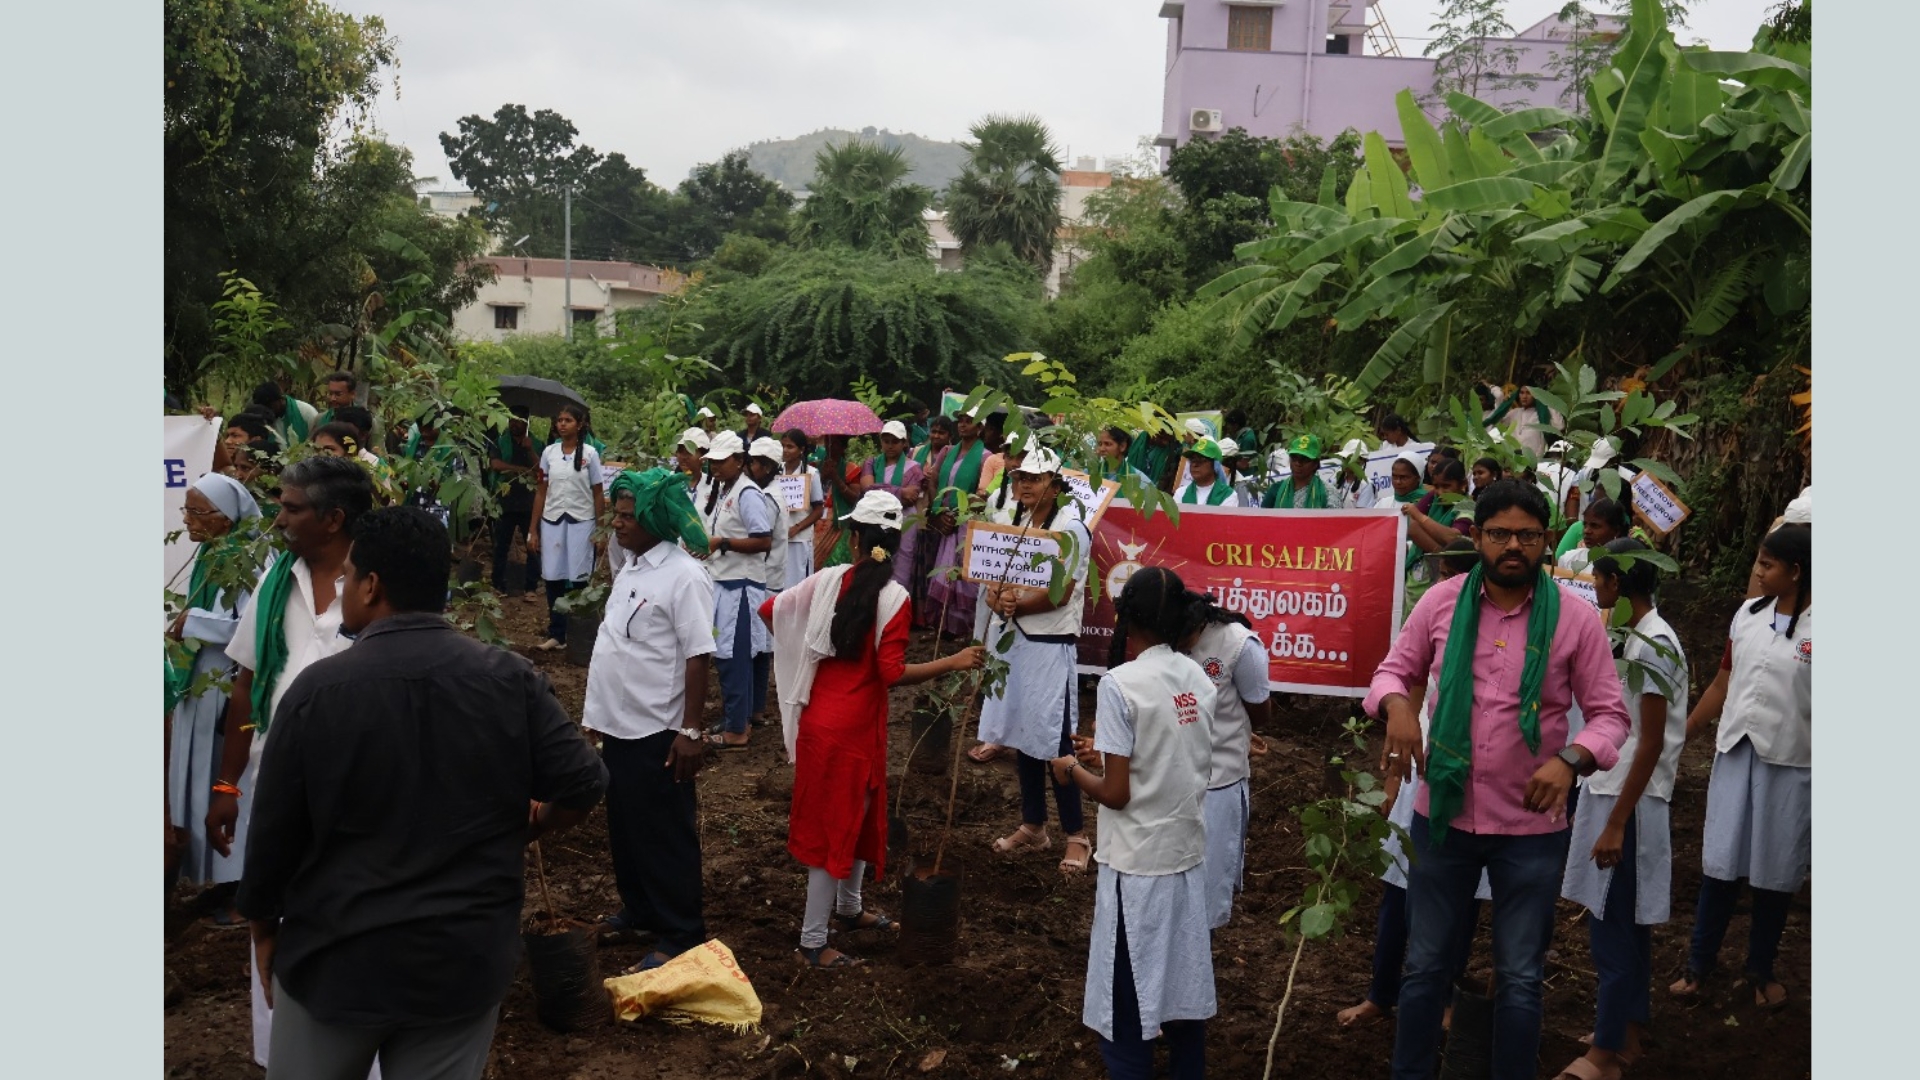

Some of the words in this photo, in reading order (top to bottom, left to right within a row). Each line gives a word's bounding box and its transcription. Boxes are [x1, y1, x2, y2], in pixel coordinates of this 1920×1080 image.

[990, 532, 999, 541] A
[1002, 534, 1041, 547] WORLD
[1206, 542, 1253, 566] CRI
[1261, 544, 1355, 572] SALEM
[982, 559, 992, 567] IS
[1005, 561, 1044, 573] WORLD
[971, 570, 1020, 584] WITHOUT
[1173, 692, 1197, 709] NSS
